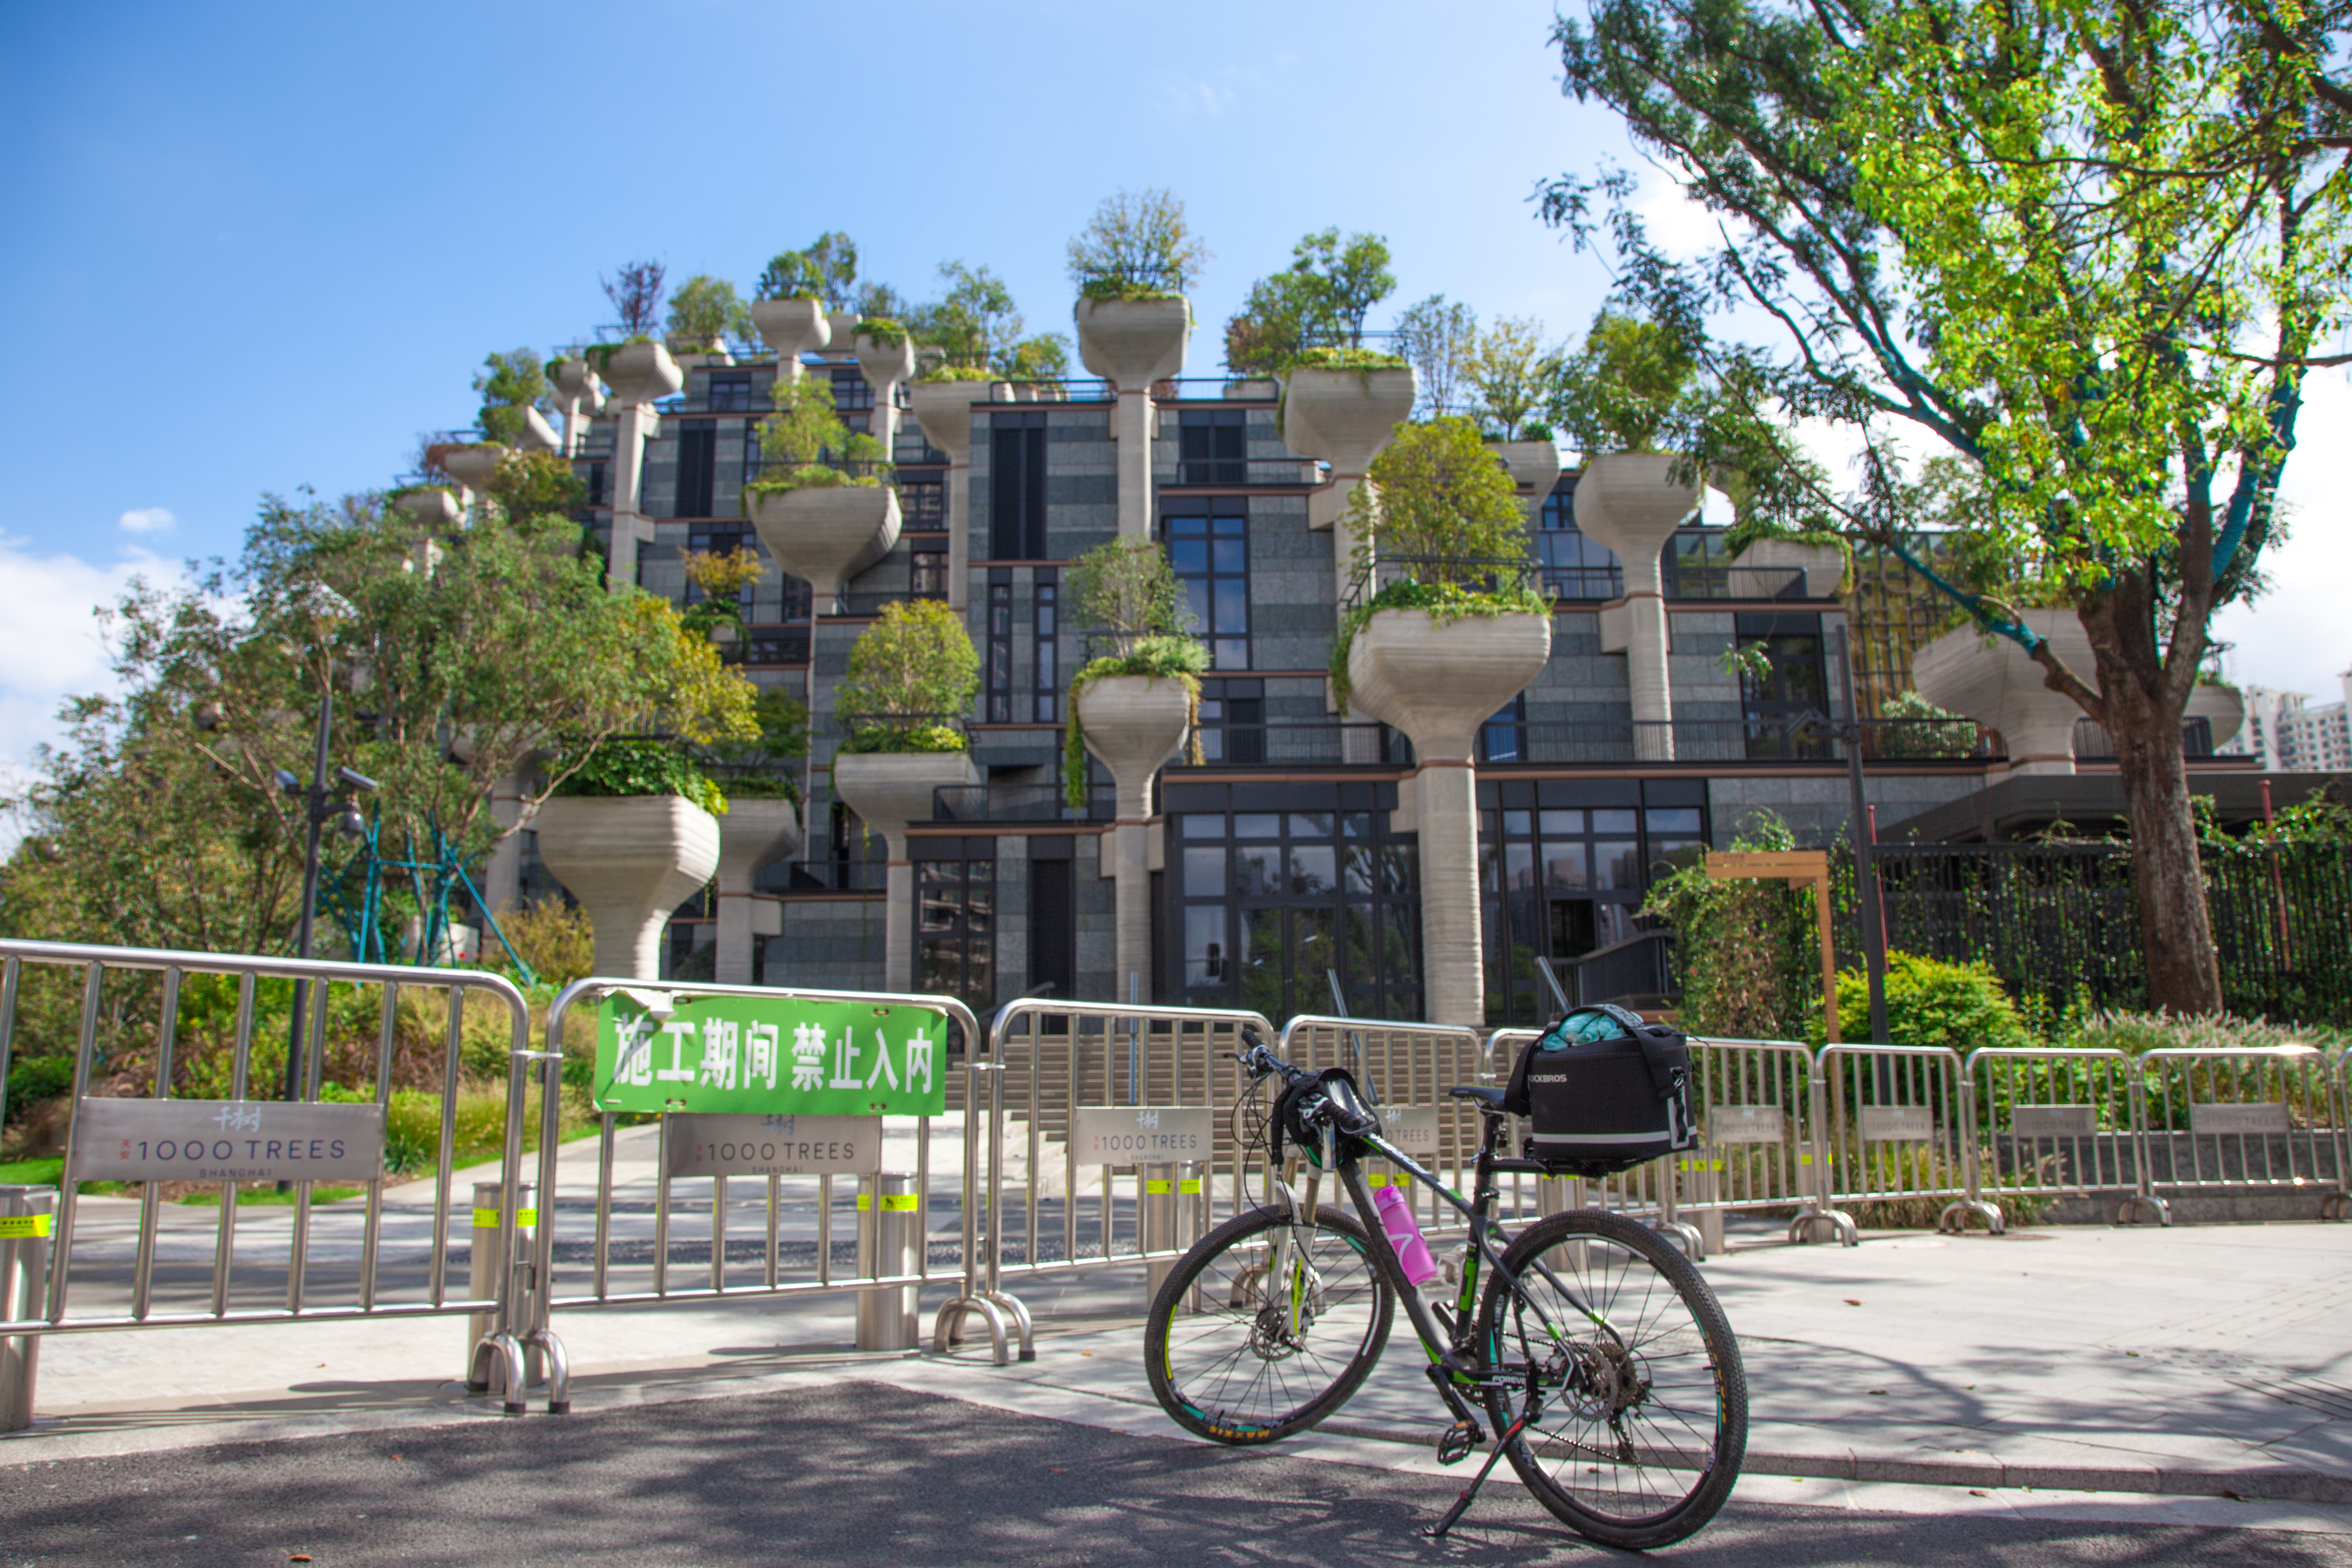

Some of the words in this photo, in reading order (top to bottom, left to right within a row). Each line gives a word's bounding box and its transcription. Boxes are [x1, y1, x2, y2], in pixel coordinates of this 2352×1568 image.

[791, 1022, 933, 1094] 禁止入内
[1102, 1135, 1147, 1151] 1000
[1150, 1134, 1197, 1150] TREES
[1396, 1129, 1429, 1143] TREES
[137, 1140, 234, 1161] 1000
[245, 1139, 345, 1160] TREES
[708, 1143, 776, 1161] 1000
[783, 1142, 854, 1160] TREES
[199, 1168, 271, 1179] SHANGHAI
[751, 1165, 804, 1175] SHANGHAI
[1493, 1375, 1526, 1385] FOREVE
[1208, 1425, 1270, 1440] MAXXIS
